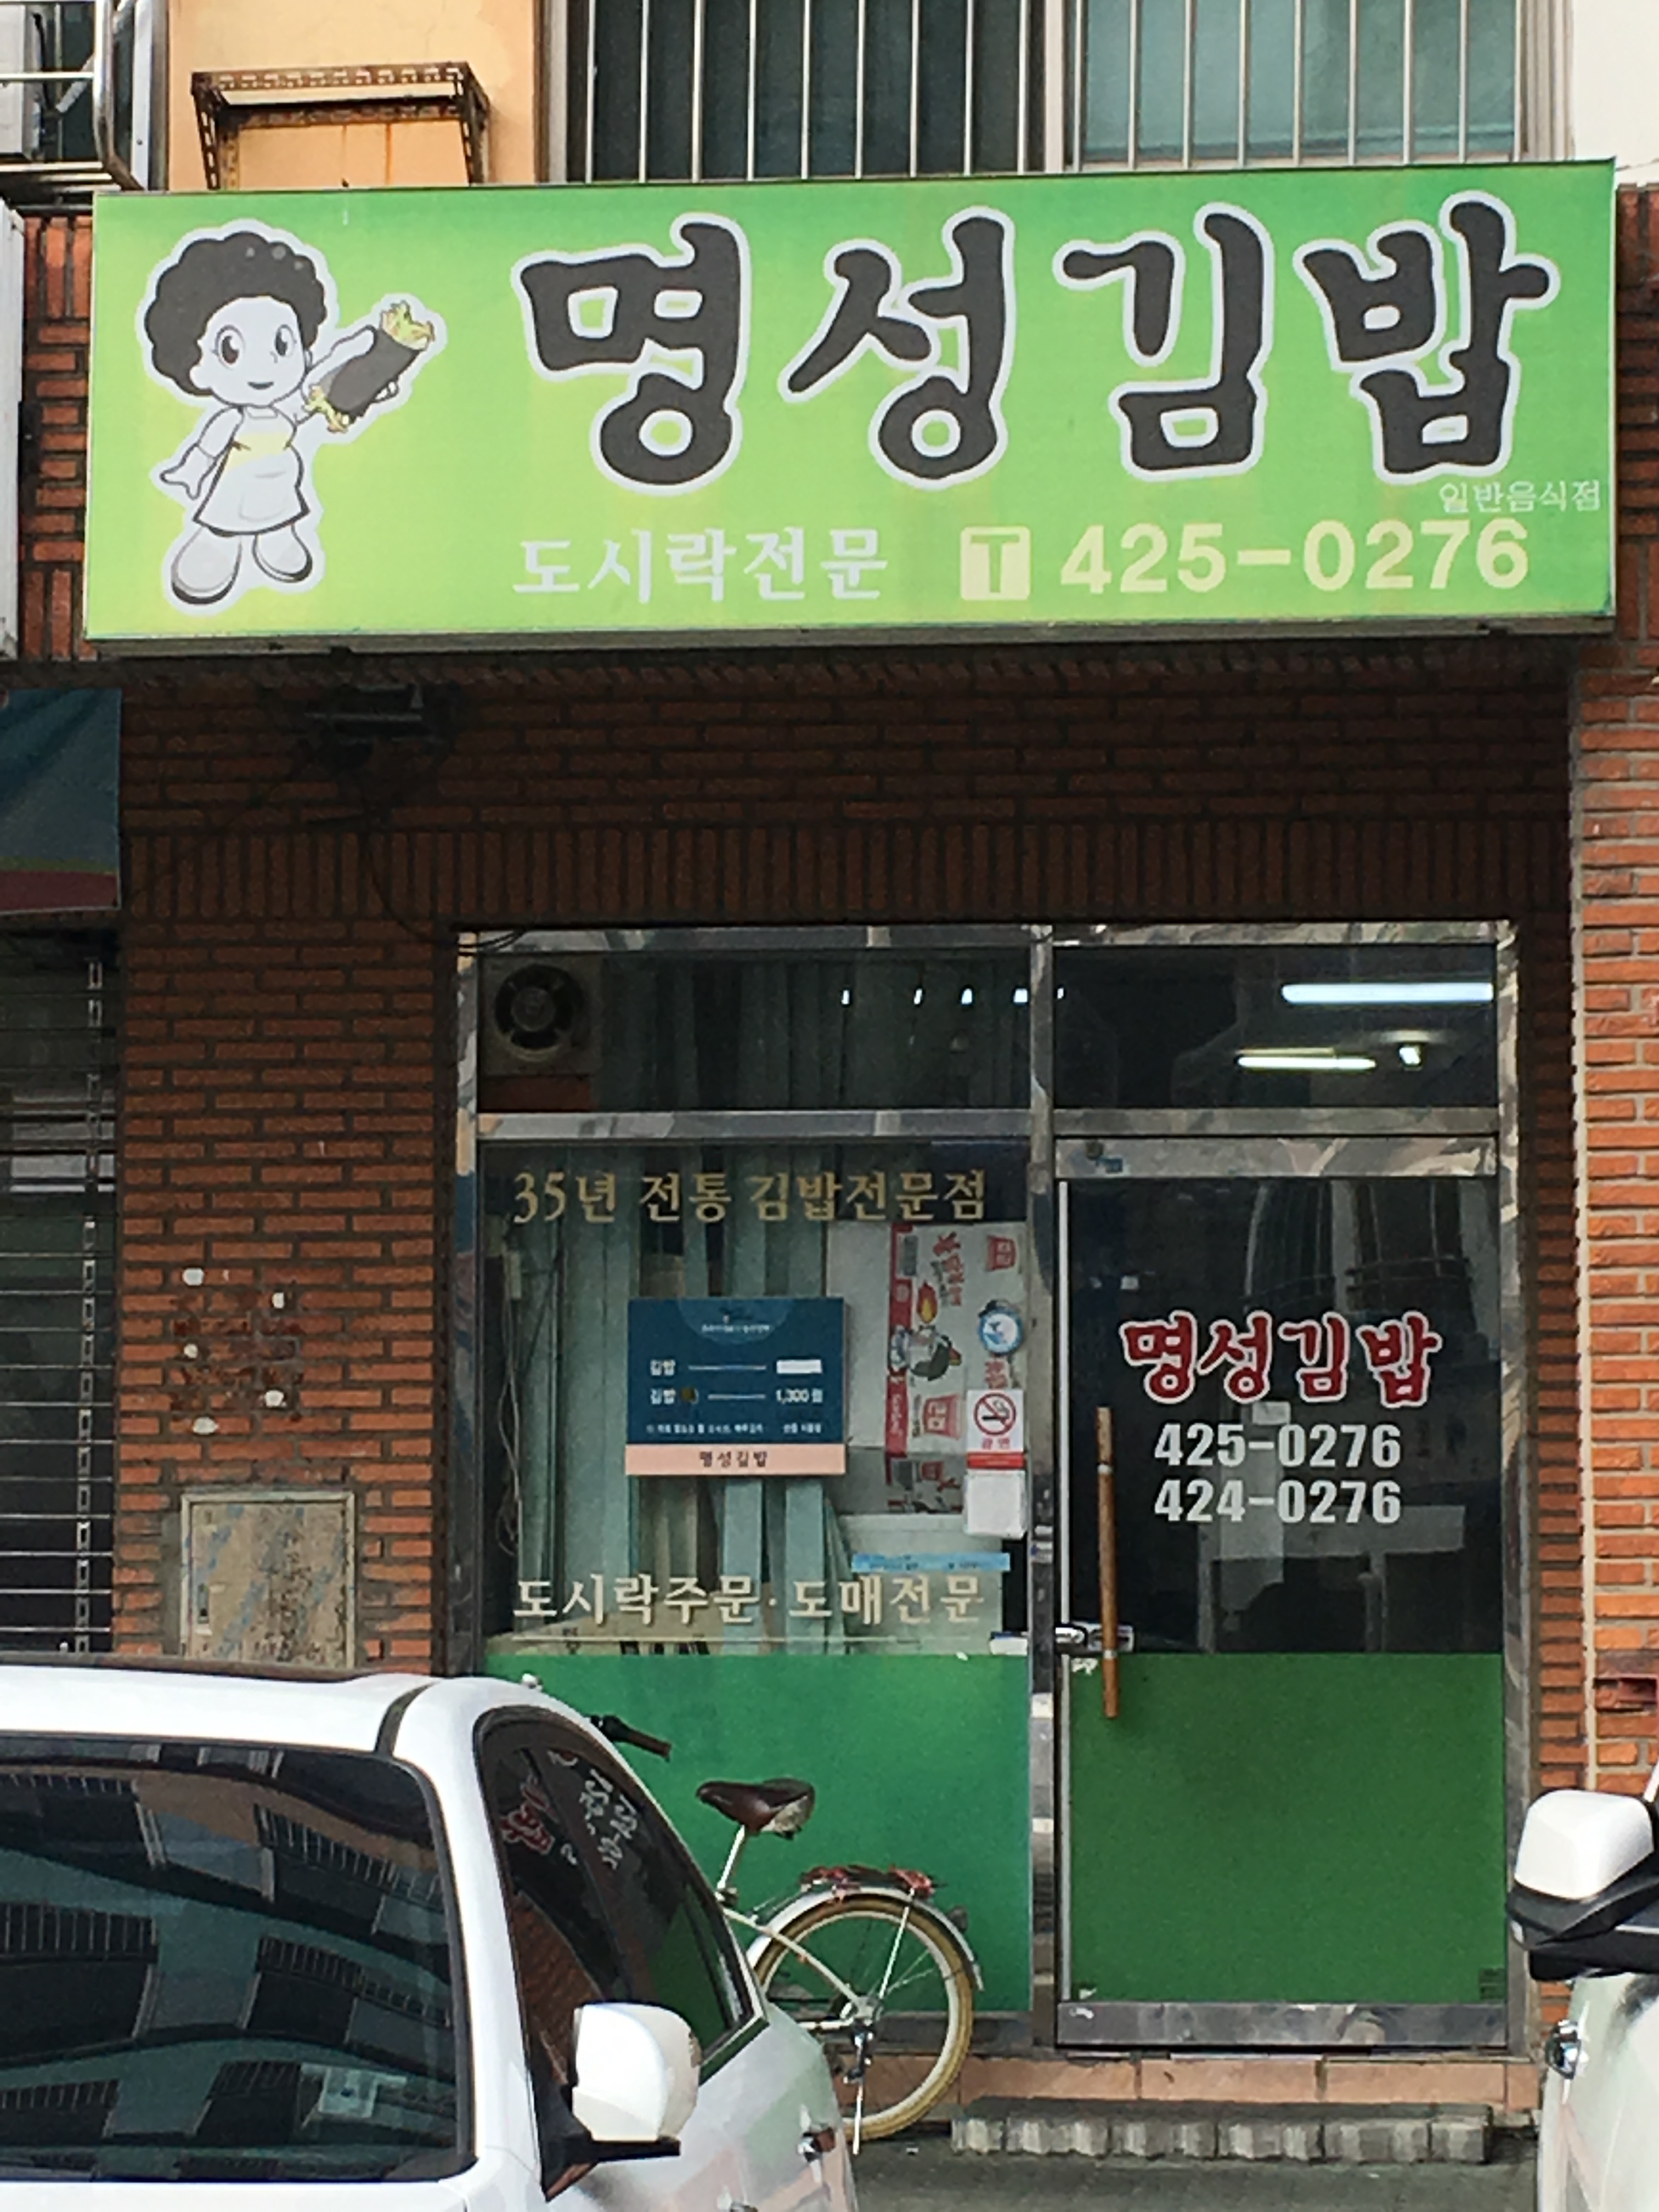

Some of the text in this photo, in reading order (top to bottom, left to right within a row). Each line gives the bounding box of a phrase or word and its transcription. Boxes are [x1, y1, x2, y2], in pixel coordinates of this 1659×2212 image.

[512, 192, 1559, 491] 명성김밥
[1438, 479, 1601, 514] 일반음식점
[512, 527, 888, 604] 도시락전문
[1060, 518, 1529, 594] 425-0276
[514, 1169, 985, 1224] 35년 전통 김밥전문점
[1119, 1310, 1443, 1408] 명성김밥
[699, 1451, 768, 1468] 명성김밥
[1154, 1423, 1402, 1468] 425-0276
[1154, 1479, 1402, 1524] 424-0276
